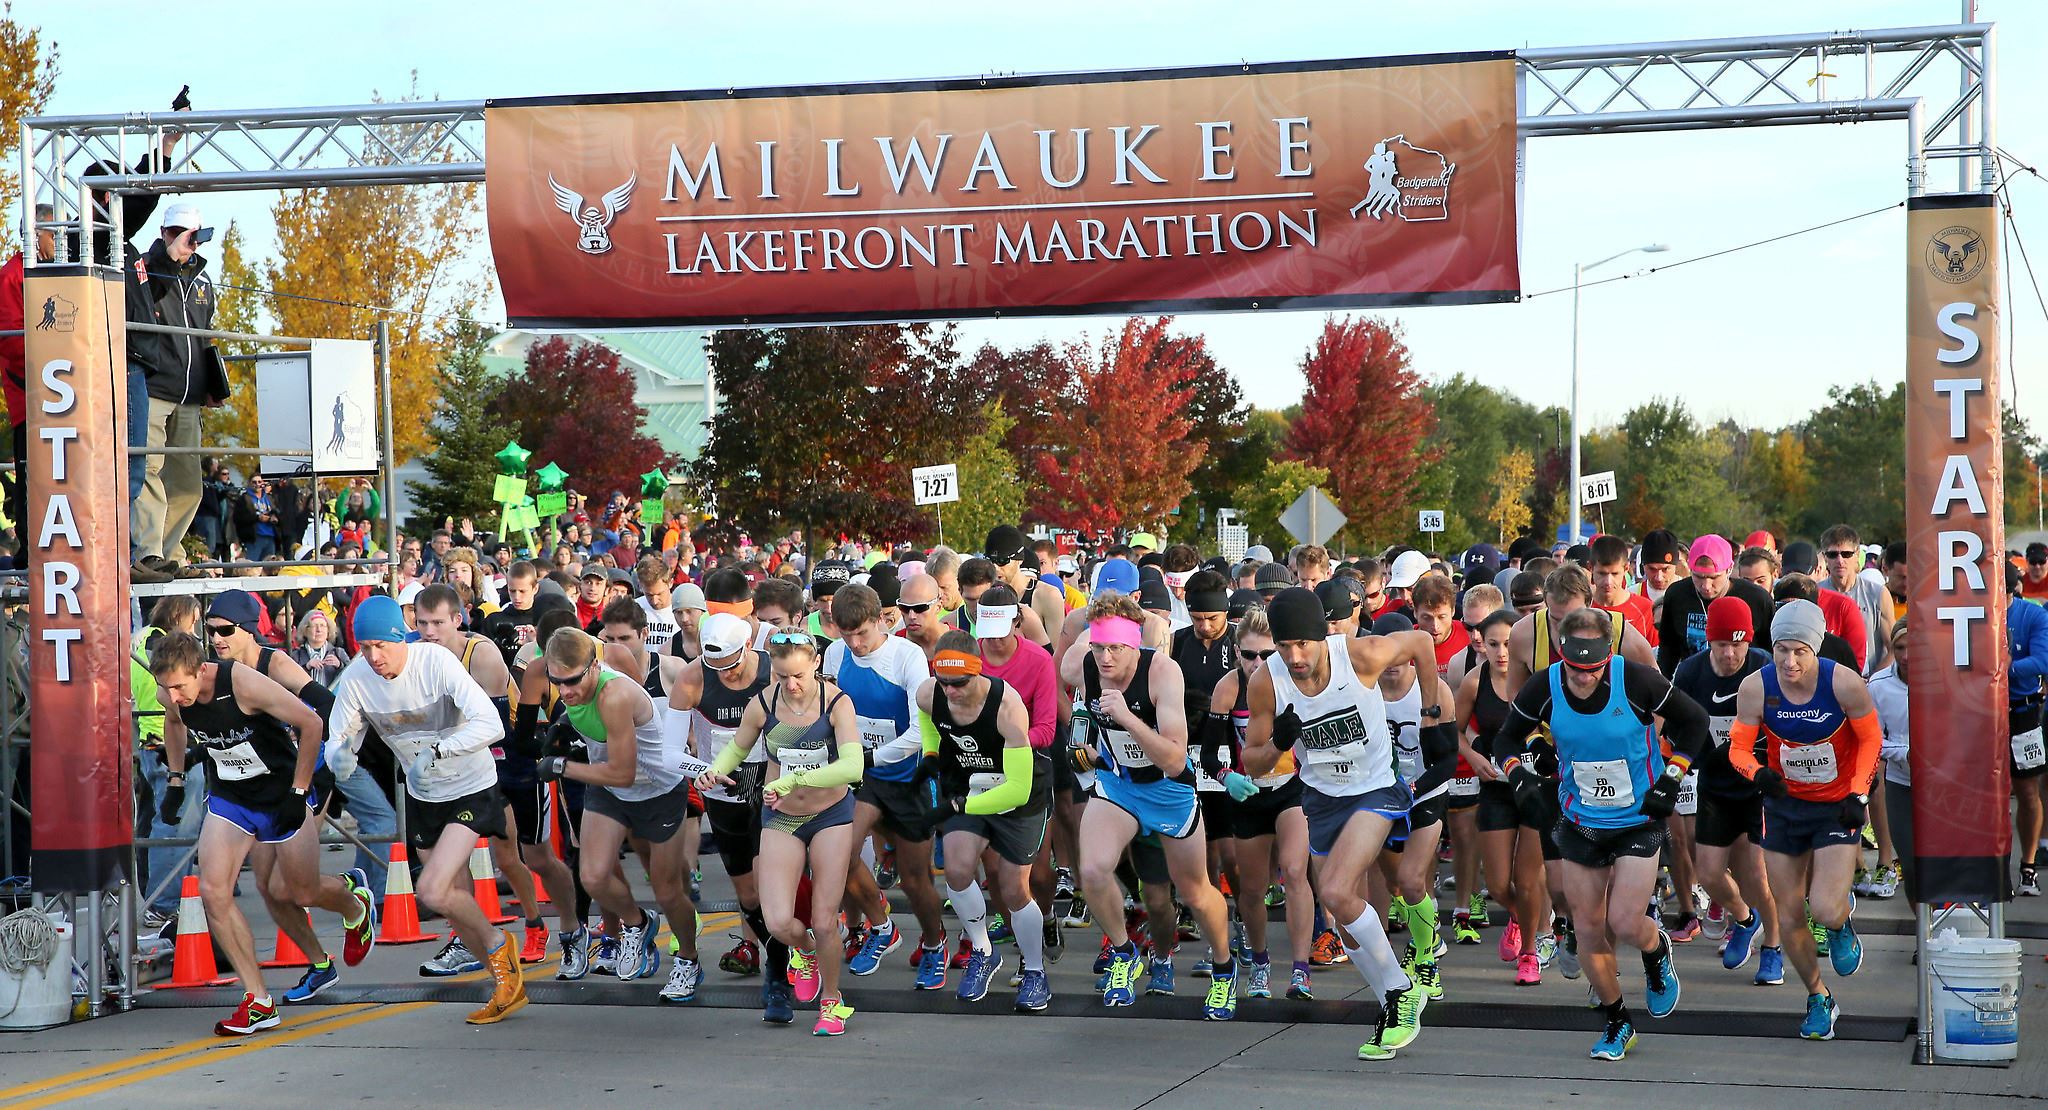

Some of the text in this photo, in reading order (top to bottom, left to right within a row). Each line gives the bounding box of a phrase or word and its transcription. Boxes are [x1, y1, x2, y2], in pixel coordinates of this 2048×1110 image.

[661, 115, 1314, 202] MILWAUKEE
[1396, 176, 1450, 190] Badgerland
[1402, 194, 1443, 207] Striders
[661, 223, 975, 275] LAKEFRONT
[991, 207, 1320, 265] MARATHON
[922, 477, 949, 498] 7:27
[1931, 301, 1989, 667] START
[1587, 482, 1610, 499] 8:01
[38, 359, 84, 683] START
[1423, 517, 1441, 528] 3:45
[1776, 708, 1821, 719] saucony
[863, 732, 886, 743] SCOTT
[955, 754, 994, 766] WICKED
[2023, 748, 2043, 761] 1374
[221, 757, 254, 768] BRADLEY
[687, 762, 708, 774] cep
[1785, 757, 1830, 768] NICHOLAS
[237, 766, 247, 775] 2
[1332, 764, 1350, 774] 10
[1805, 766, 1812, 774] 1
[1595, 777, 1609, 786] ED
[1592, 785, 1616, 798] 720
